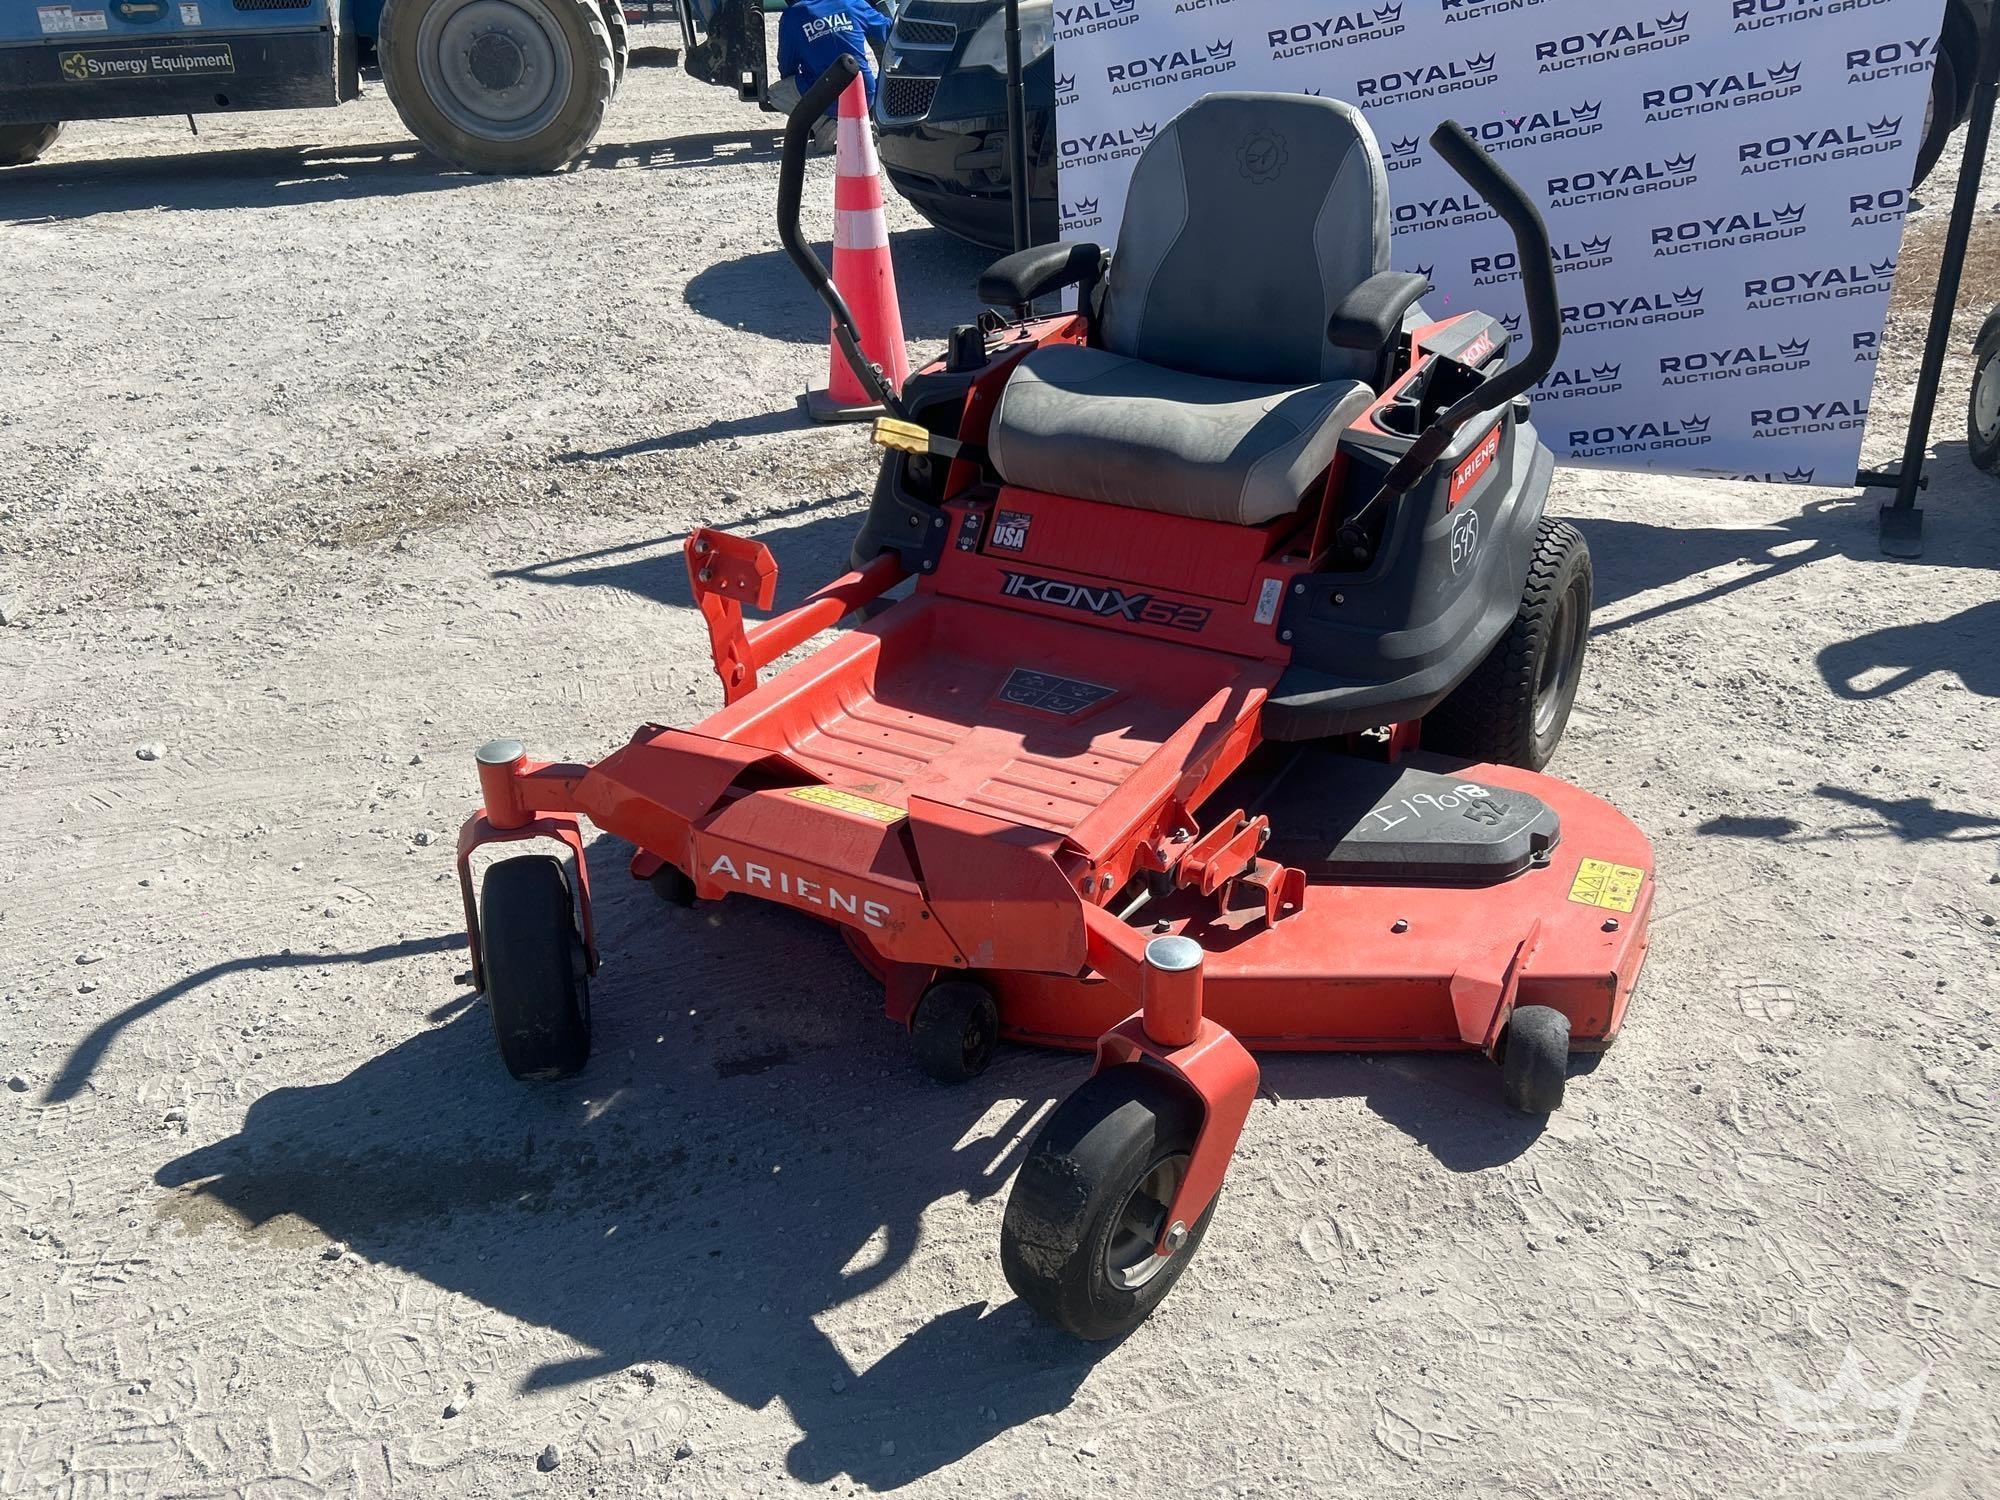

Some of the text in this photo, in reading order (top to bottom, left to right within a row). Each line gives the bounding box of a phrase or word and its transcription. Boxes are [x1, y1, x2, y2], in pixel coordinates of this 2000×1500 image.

[802, 13, 852, 37] ROYAL
[1053, 2, 1110, 25] YAL
[1444, 0, 1524, 24] AUCTION
[1734, 6, 1823, 33] AUCTION
[1053, 14, 1140, 41] TION GROUP
[1267, 12, 1374, 47] ROYAL
[1535, 22, 1656, 61] ROYAL
[1272, 24, 1405, 61] AUCTION GROUP
[1538, 34, 1690, 74] AUCTION GROUP
[1846, 37, 1938, 70] ROY
[88, 53, 231, 75] Synergy Equipment
[1107, 48, 1207, 82] ROYAL
[1112, 60, 1236, 95] AUCTION GROUP
[1357, 62, 1466, 97] ROYAL
[1360, 74, 1498, 110] AUCTION GROUP
[1643, 71, 1766, 109] ROYAL
[1645, 85, 1802, 123] AUCTION GROUP
[1059, 130, 1134, 157] OYAL
[1483, 123, 1603, 153] CTION GROUP
[1739, 125, 1866, 161] ROYAL
[1057, 146, 1145, 170] UCTION GRO
[1387, 157, 1422, 171] OUP
[1740, 139, 1902, 175] AUCTION GROUP
[1547, 162, 1663, 196] ROYAL
[1550, 175, 1697, 208] AUCTION GROUP
[1391, 195, 1480, 223] OYAL
[1391, 211, 1502, 236] UCTION GROU
[1851, 211, 1906, 227] AUCT
[1652, 212, 1771, 245] ROYAL
[1653, 226, 1806, 257] AUCTION GROUP
[1473, 257, 1613, 286] AUCTI GROUP
[1745, 265, 1868, 297] ROYAL
[1560, 294, 1672, 323] ROYAL
[1746, 282, 1891, 310] AUCTION GROU
[1561, 309, 1705, 335] AUCTION GROUP
[1660, 345, 1777, 374] ROYAL
[1662, 360, 1811, 386] AUCTION GROUP
[1537, 369, 1591, 388] YAL
[1563, 383, 1622, 398] GROUP
[1751, 400, 1868, 426] ROYAL
[1569, 421, 1679, 447] ROYAL
[1752, 422, 1835, 438] AUCTION
[1571, 435, 1712, 459] AUCTION GROUP
[1457, 438, 1495, 490] ARIENS
[993, 525, 1025, 548] USA
[1462, 798, 1510, 826] 52
[709, 854, 890, 927] ARIENS
